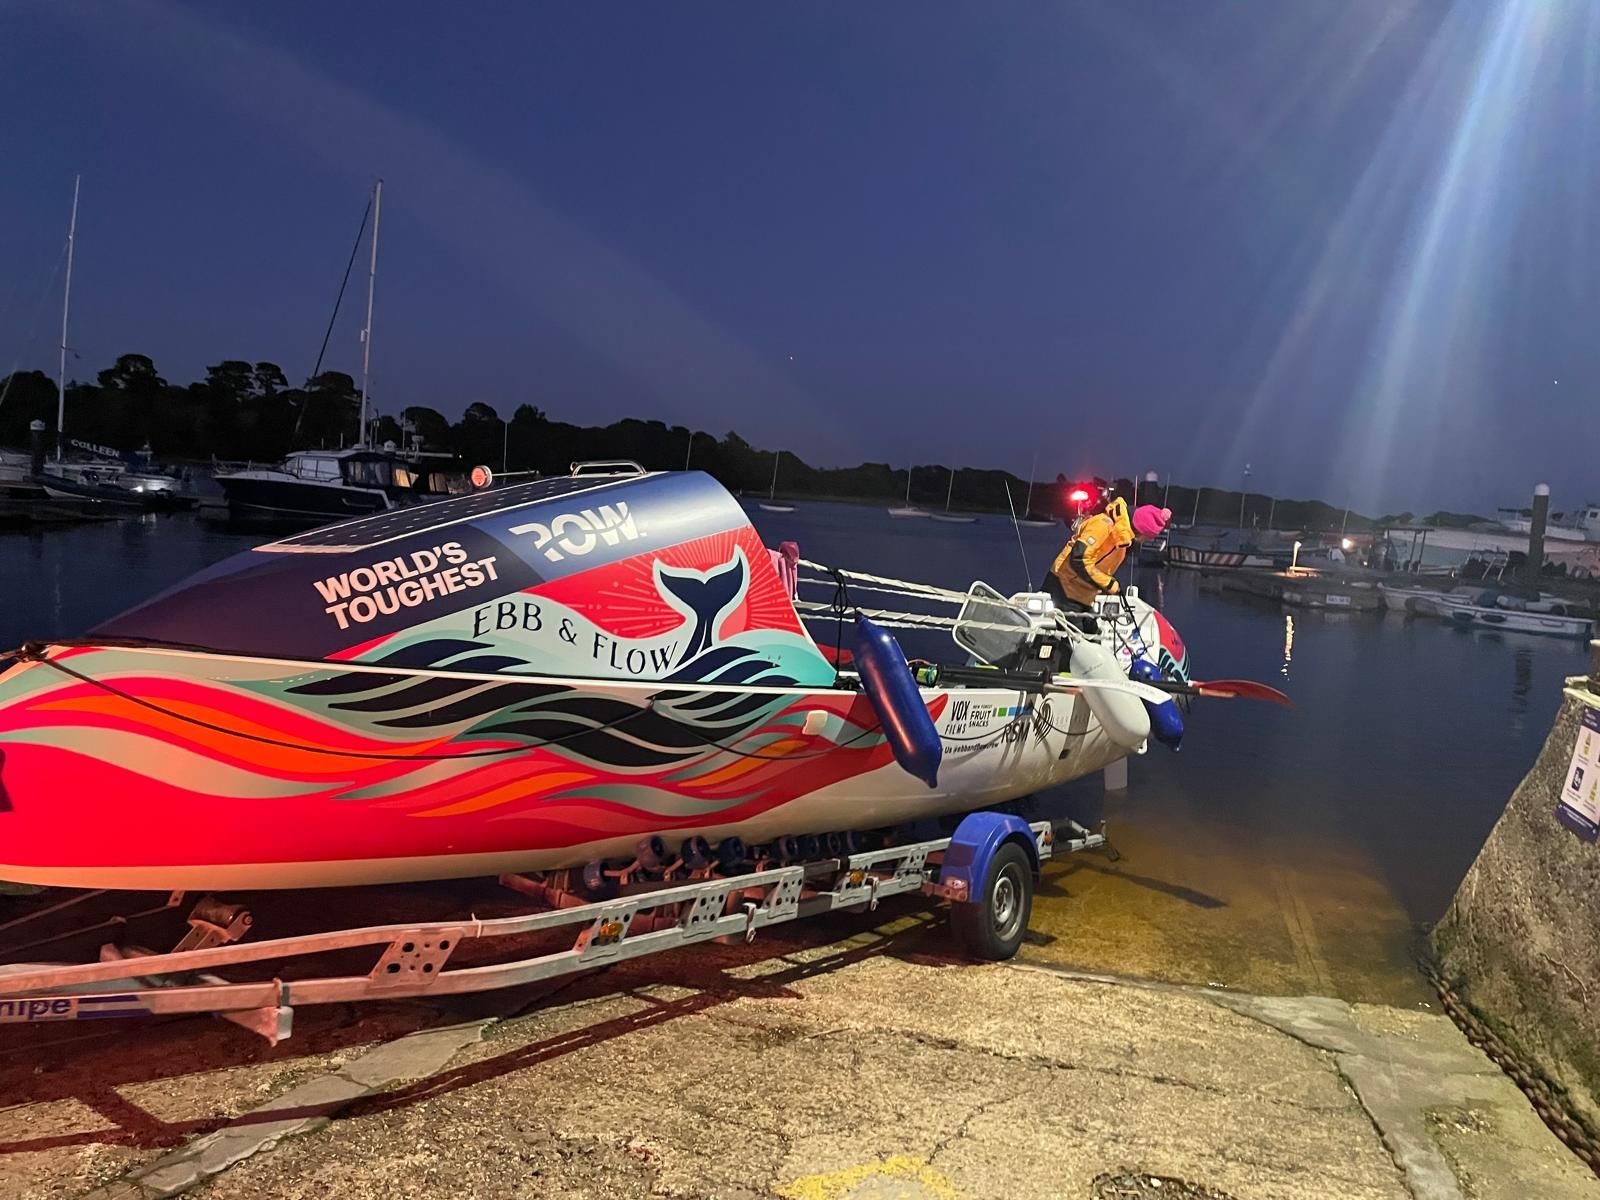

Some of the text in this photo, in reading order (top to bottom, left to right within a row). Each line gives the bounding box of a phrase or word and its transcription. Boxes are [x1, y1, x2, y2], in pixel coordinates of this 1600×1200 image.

[313, 541, 468, 603] WORLD'S
[325, 556, 499, 630] TOUGHEST
[473, 601, 679, 675] EBB & FLOW
[951, 700, 970, 721] VOX
[970, 710, 992, 720] FRUIT
[944, 723, 967, 735] FILMS
[968, 720, 989, 728] SNACKS
[1001, 721, 1031, 744] RSM
